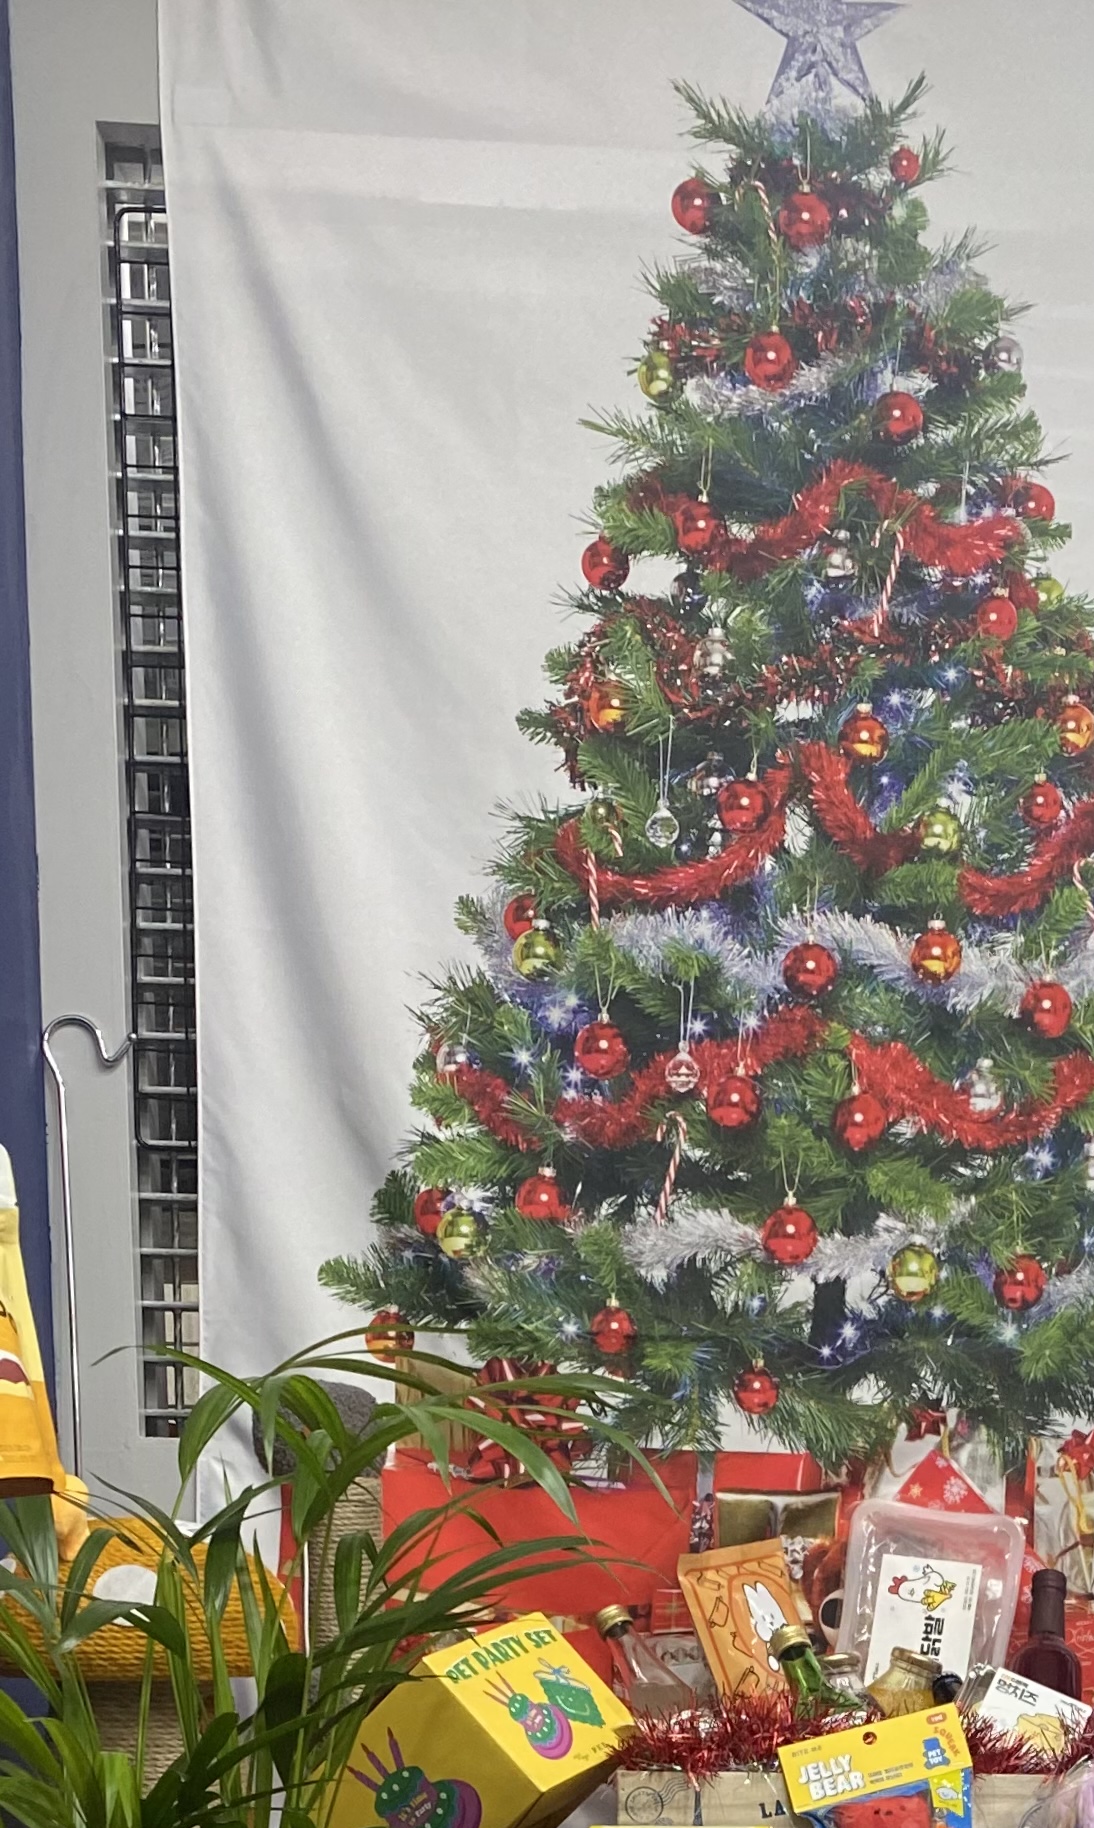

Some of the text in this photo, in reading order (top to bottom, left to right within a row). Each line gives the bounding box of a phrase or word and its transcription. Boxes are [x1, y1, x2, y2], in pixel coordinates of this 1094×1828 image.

[919, 1613, 946, 1661] 닭발
[445, 1629, 559, 1684] PET PARTY SET
[797, 1752, 853, 1785] JELLY
[929, 1756, 943, 1765] TOY
[808, 1771, 866, 1802] BEAR
